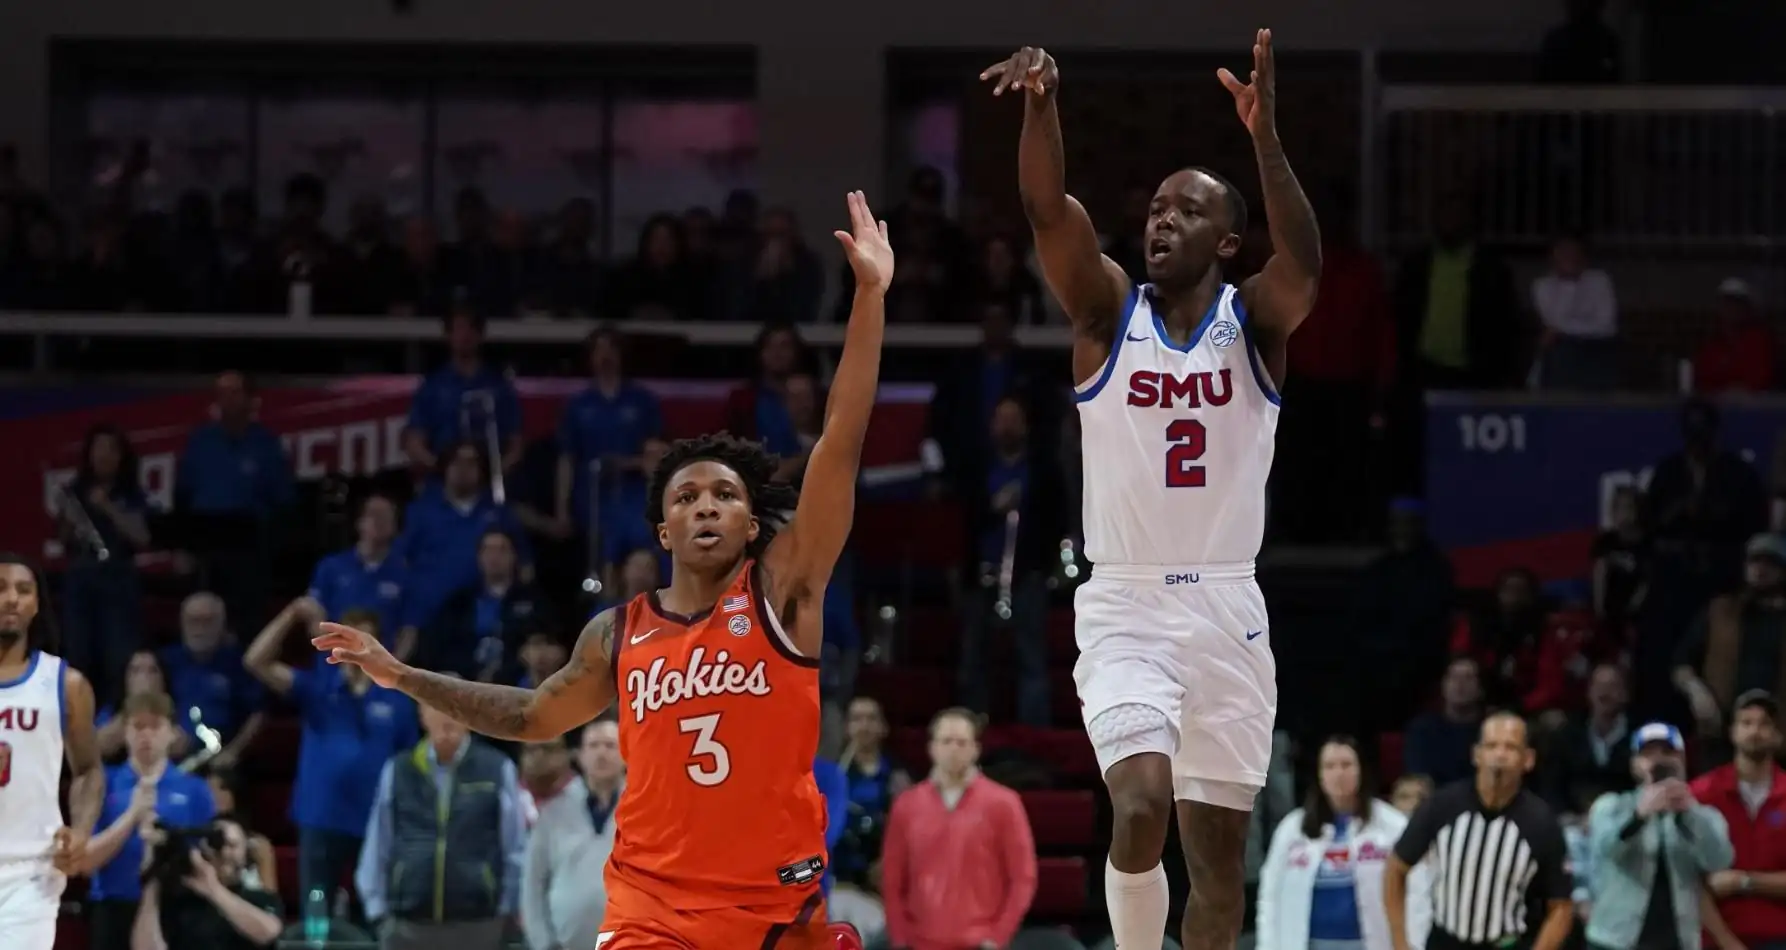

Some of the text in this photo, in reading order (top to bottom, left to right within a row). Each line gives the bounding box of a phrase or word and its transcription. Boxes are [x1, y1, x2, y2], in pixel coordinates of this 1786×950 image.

[1127, 368, 1233, 408] SMU
[1165, 419, 1206, 488] 2
[1458, 413, 1526, 453] 101
[1165, 573, 1199, 584] SMU
[627, 645, 772, 723] Hokies
[678, 711, 731, 786] 3
